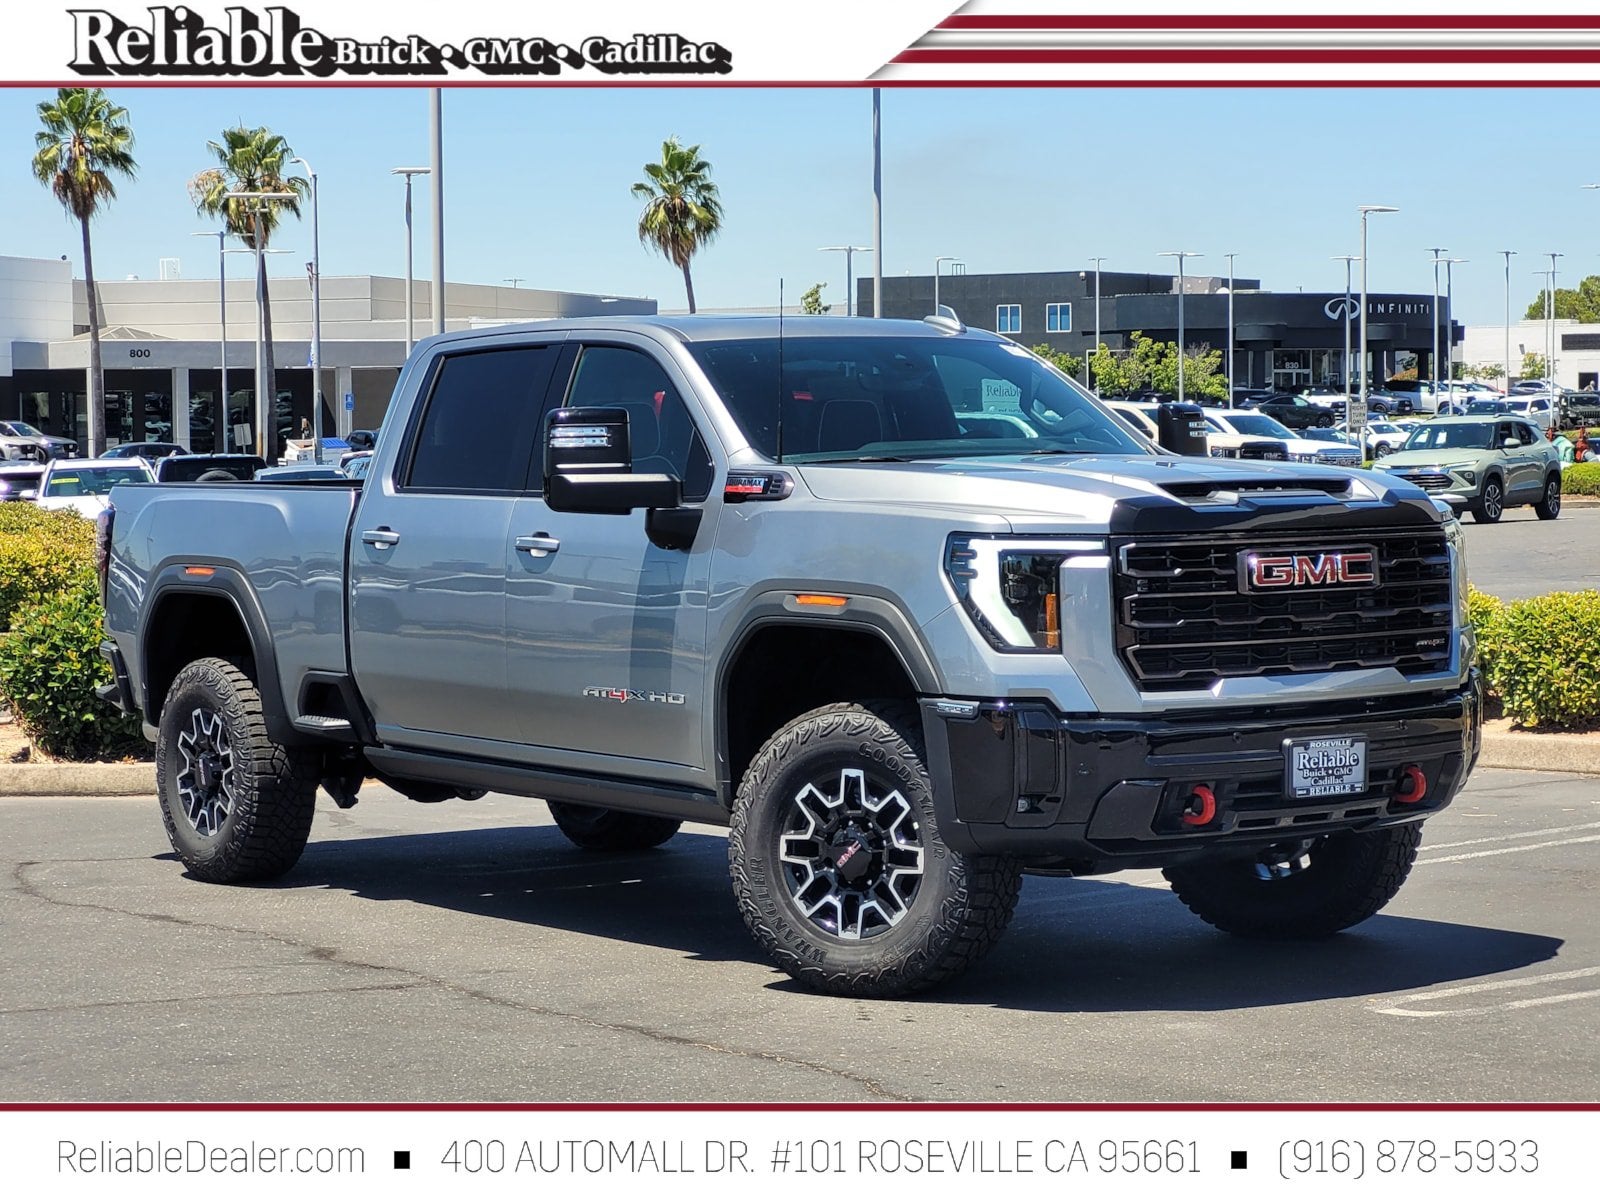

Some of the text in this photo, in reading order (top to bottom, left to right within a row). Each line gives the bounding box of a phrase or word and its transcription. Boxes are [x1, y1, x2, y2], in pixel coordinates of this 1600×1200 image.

[1369, 303, 1429, 314] INFINITI
[129, 349, 150, 358] 800
[1285, 361, 1299, 369] 830
[986, 384, 1019, 397] Reliabl
[727, 477, 764, 487] DURAMAX
[1253, 553, 1374, 586] GMC
[649, 691, 686, 705] HD
[1310, 738, 1352, 749] ROSEVILLE
[1297, 748, 1359, 771] Reliable
[1303, 766, 1353, 779] Buick GMC
[1310, 776, 1344, 787] Cadillac
[1310, 784, 1352, 797] RELIABLE
[860, 741, 946, 860] GOODYEAR
[836, 840, 861, 868] GMC
[750, 857, 829, 966] WRANGLER
